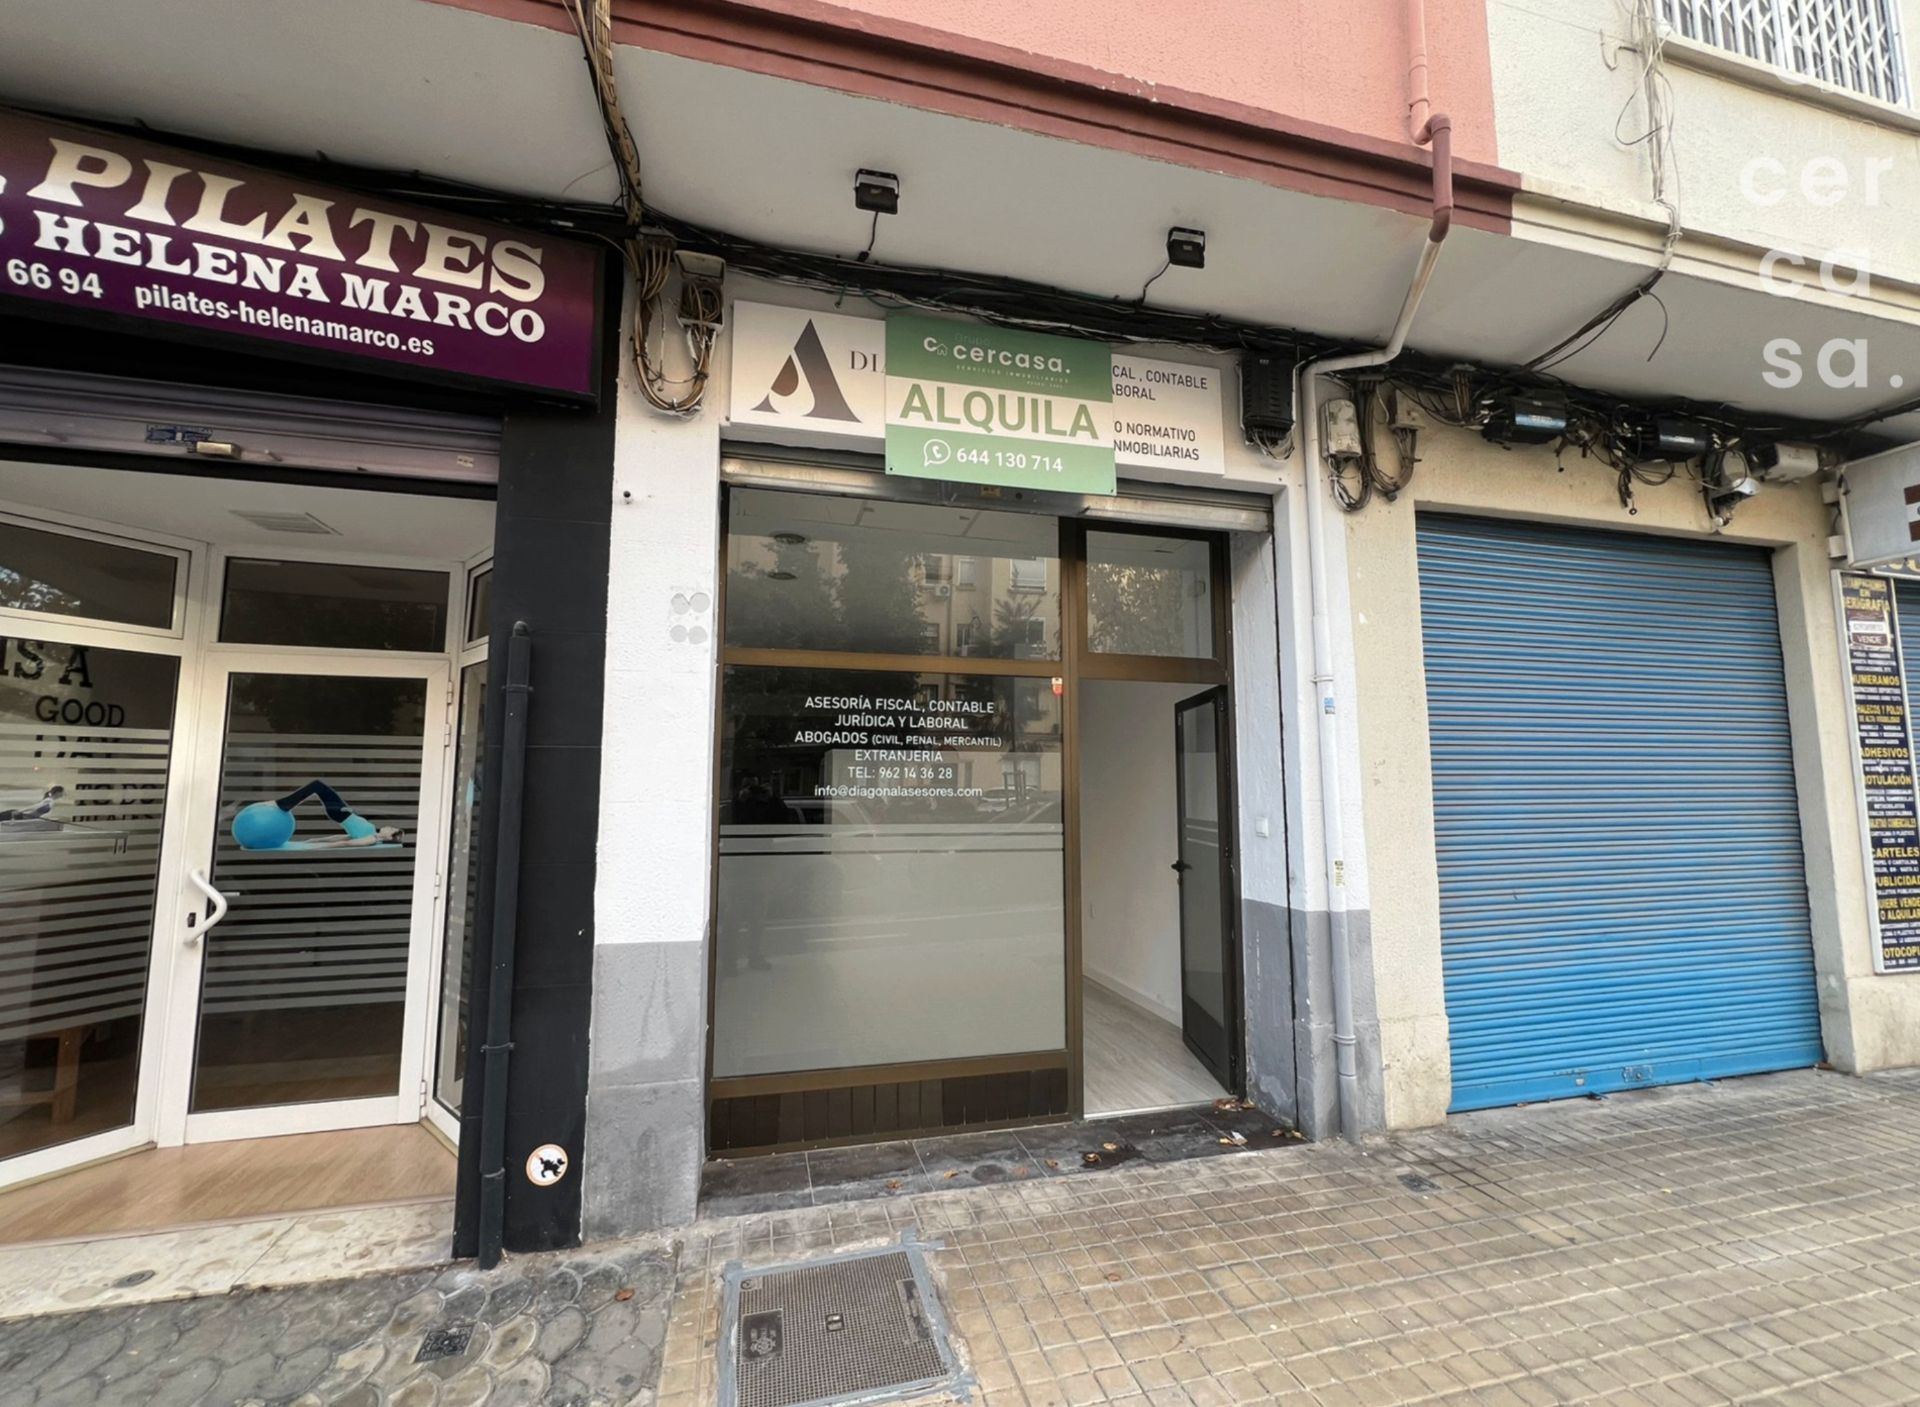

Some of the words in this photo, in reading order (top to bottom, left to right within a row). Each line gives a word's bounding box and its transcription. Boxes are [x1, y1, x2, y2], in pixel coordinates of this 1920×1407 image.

[26, 138, 546, 302] PILATES
[33, 210, 331, 303] HELENA
[341, 273, 546, 343] MARCO
[7, 258, 52, 290] 66
[58, 267, 104, 299] 94
[134, 283, 435, 356] pilates-helenamarco.es
[952, 344, 1071, 374] cercasa.
[1145, 369, 1208, 390] CONTABLE
[899, 383, 1099, 440] ALQUILA
[1126, 421, 1196, 442] NORMATIVO
[956, 447, 990, 465] 644
[995, 452, 1027, 469] 130
[1031, 455, 1063, 472] 714
[35, 695, 125, 728] GOOD
[804, 695, 872, 710] ASESORÍA
[875, 698, 926, 713] FISCAL,
[929, 700, 995, 714] CONTABLE
[834, 712, 895, 728] JURÍDICA
[899, 715, 907, 728] Y
[909, 716, 969, 730] LABORAL
[794, 731, 868, 744] ABOGADOS
[871, 735, 904, 747] (CIVIL,
[906, 736, 942, 748] PENAL,
[943, 737, 1002, 748] MERCANTIL)
[848, 767, 876, 779] TEL:
[879, 767, 900, 779] 962
[903, 767, 916, 779] 14
[920, 768, 935, 779] 36
[938, 768, 953, 780] 28
[814, 784, 983, 798] info@diagonalasesores.com
